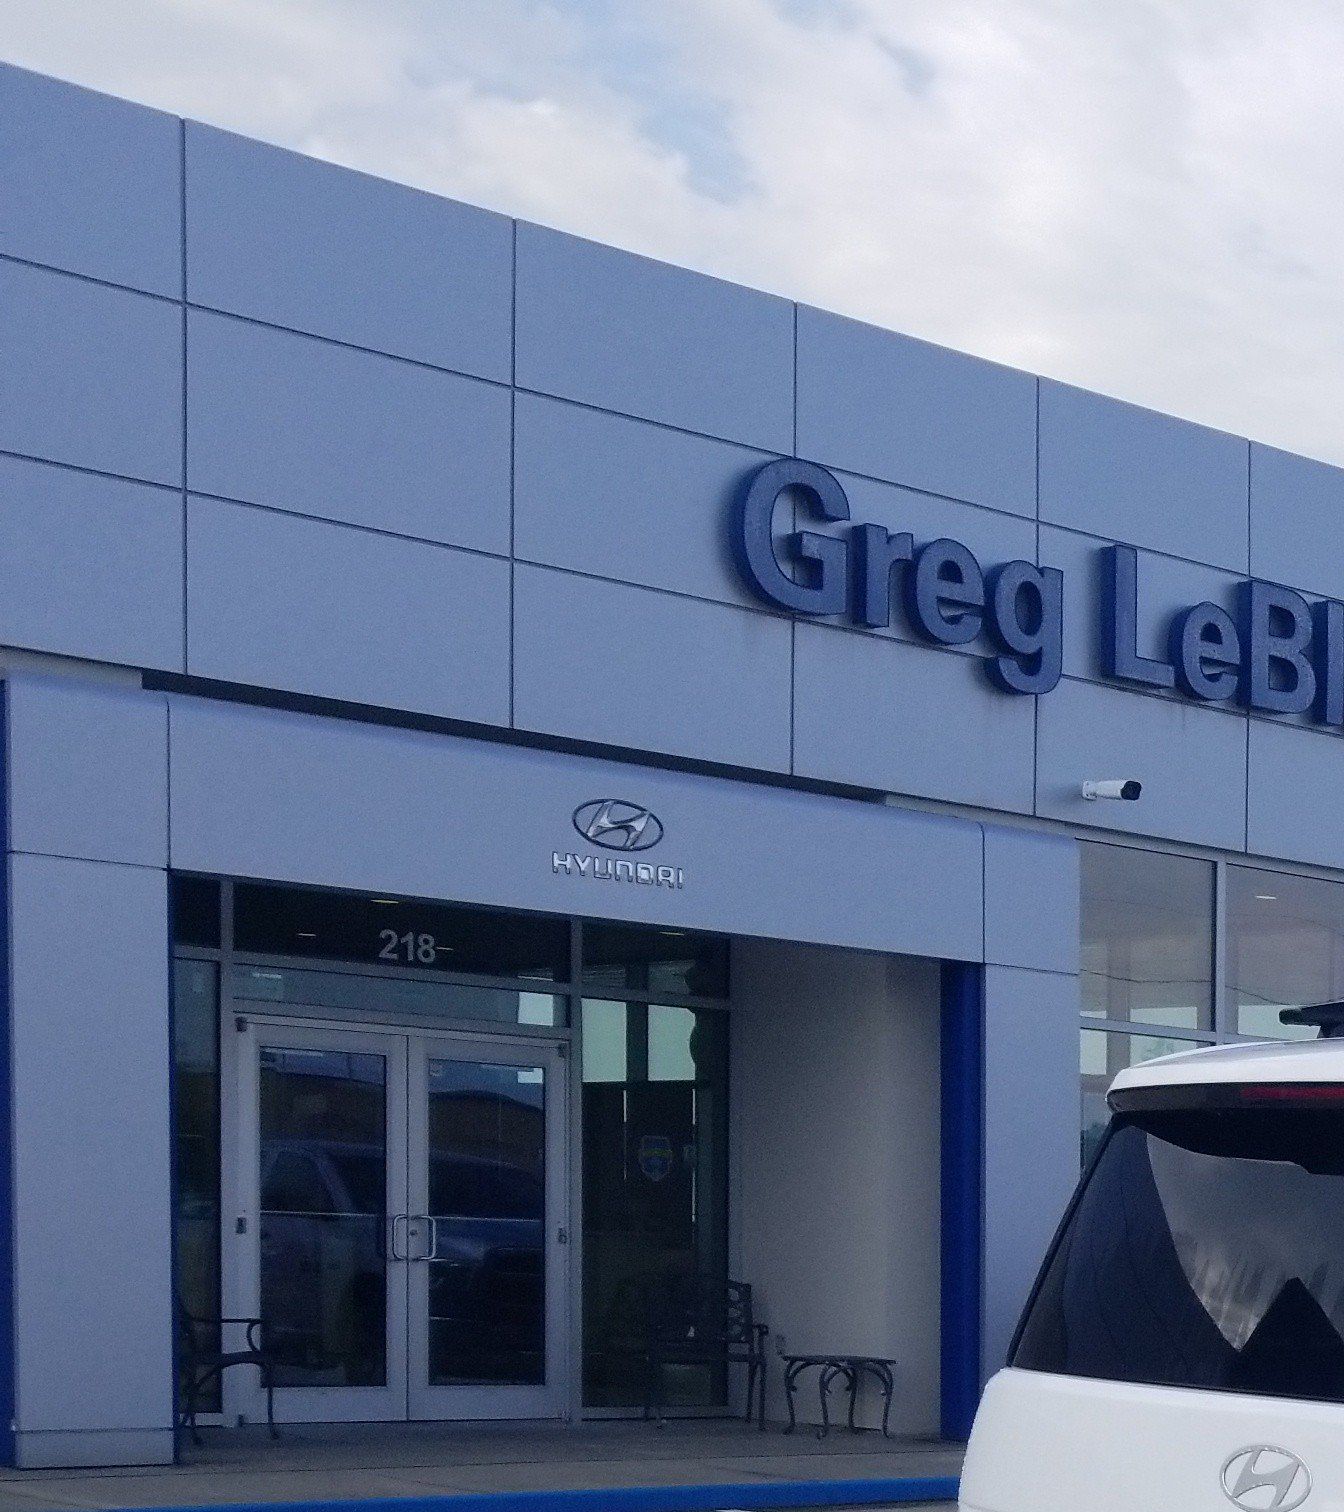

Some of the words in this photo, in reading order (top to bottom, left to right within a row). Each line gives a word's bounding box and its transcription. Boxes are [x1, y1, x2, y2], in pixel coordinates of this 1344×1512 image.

[736, 457, 1064, 695] Greg
[552, 851, 683, 889] HYUNDAI
[378, 929, 436, 964] 218
